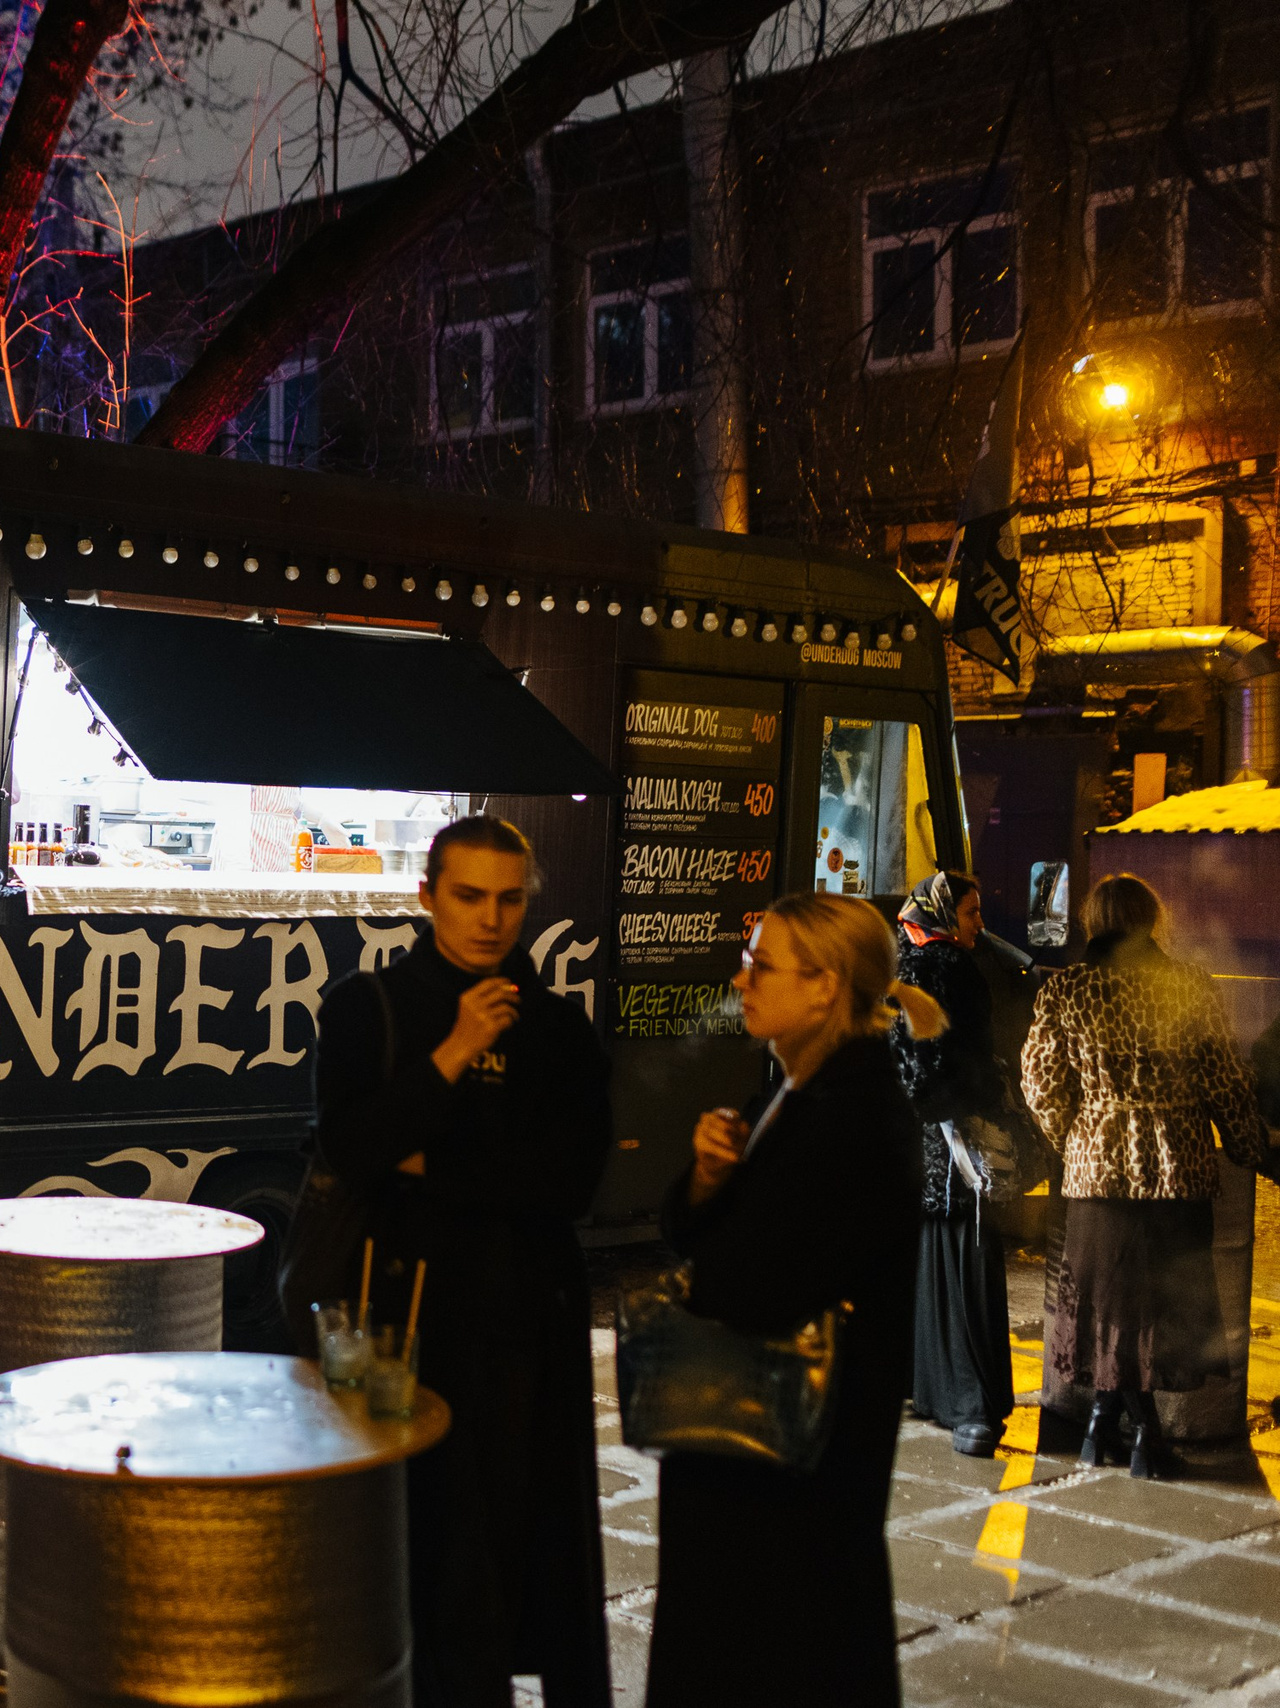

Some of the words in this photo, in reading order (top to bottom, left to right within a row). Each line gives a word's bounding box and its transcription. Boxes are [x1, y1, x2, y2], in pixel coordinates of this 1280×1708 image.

[800, 642, 860, 666] @UNDERDOG
[862, 648, 902, 670] MOSCOW
[625, 703, 690, 735] ORIGINAL
[692, 708, 720, 738] DOG
[751, 713, 777, 744] 400
[624, 776, 679, 811] MALINA
[680, 779, 722, 813] KUSH
[744, 782, 775, 817] 450
[620, 843, 688, 880] BACON
[687, 848, 738, 882] HAZE
[737, 849, 772, 883] 450
[619, 911, 671, 946] CHEESY
[670, 910, 721, 944] CHEESE
[628, 1018, 702, 1037] FRIENDLY
[706, 1018, 743, 1036] MENU
